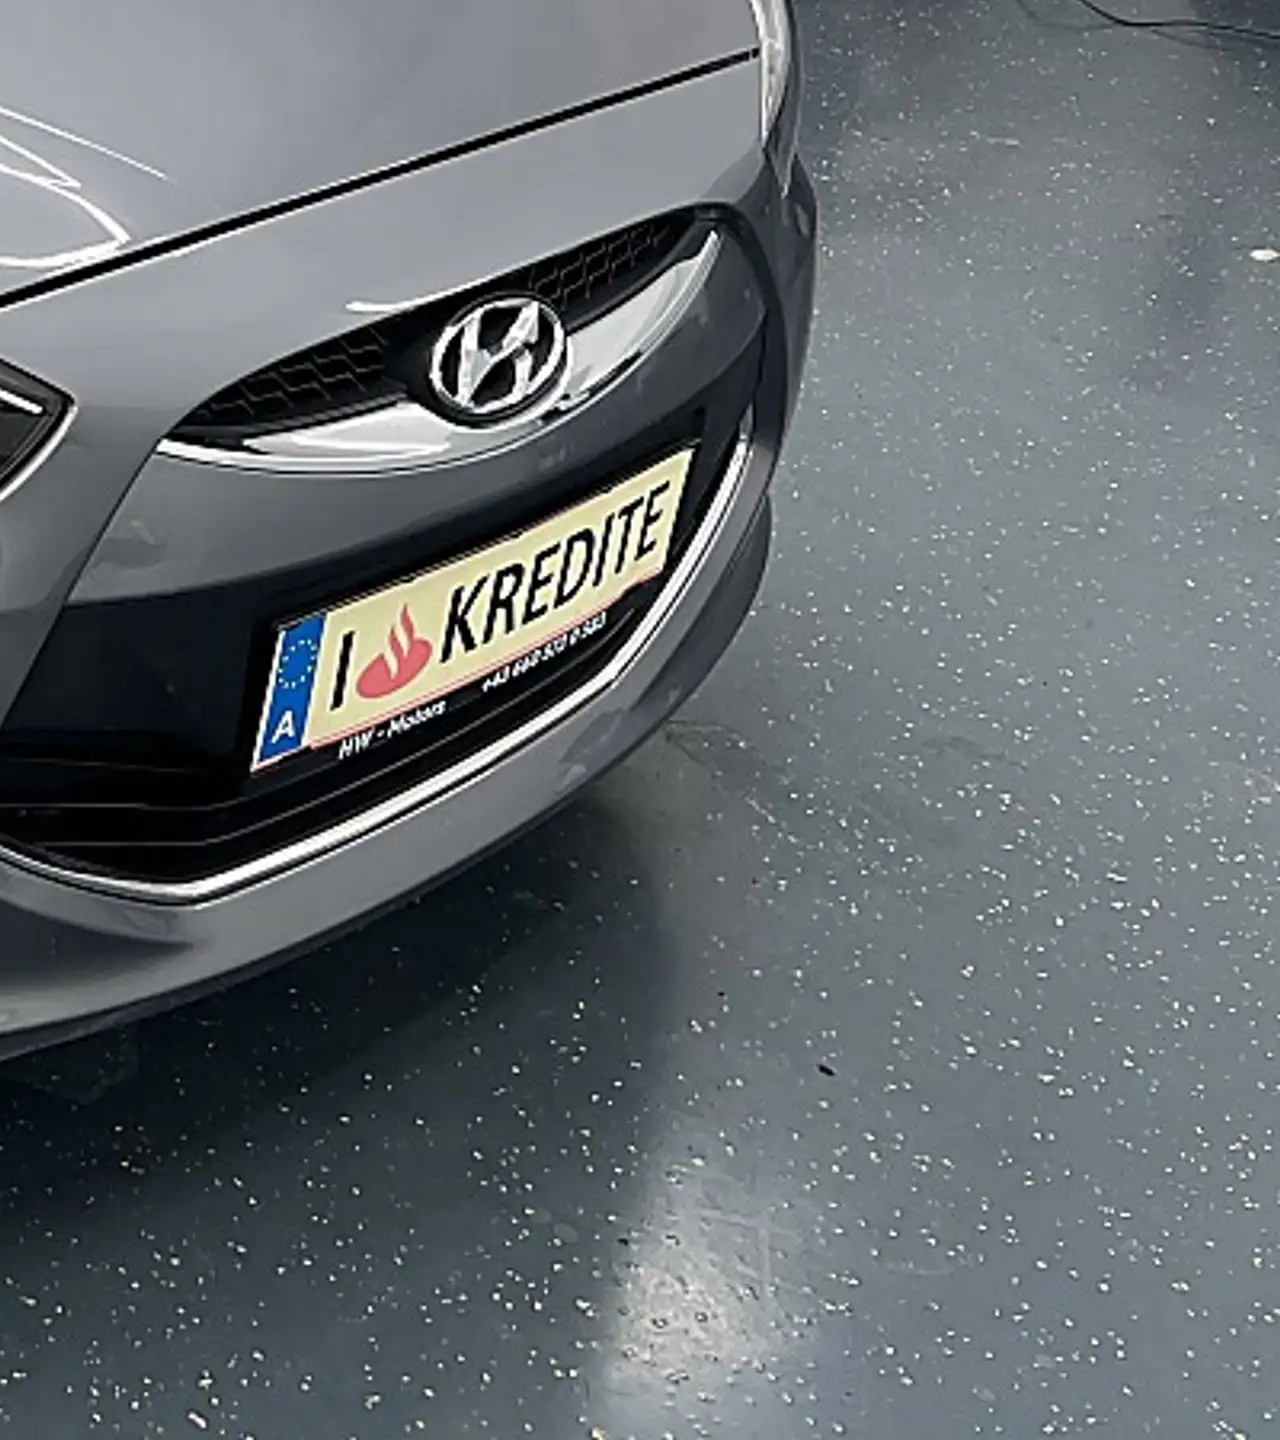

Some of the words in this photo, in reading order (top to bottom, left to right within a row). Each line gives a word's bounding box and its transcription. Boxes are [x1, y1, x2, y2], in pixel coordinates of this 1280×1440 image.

[439, 480, 671, 664] KREDITE
[271, 710, 296, 744] A
[337, 727, 375, 760] HW
[387, 700, 447, 739] Motors
